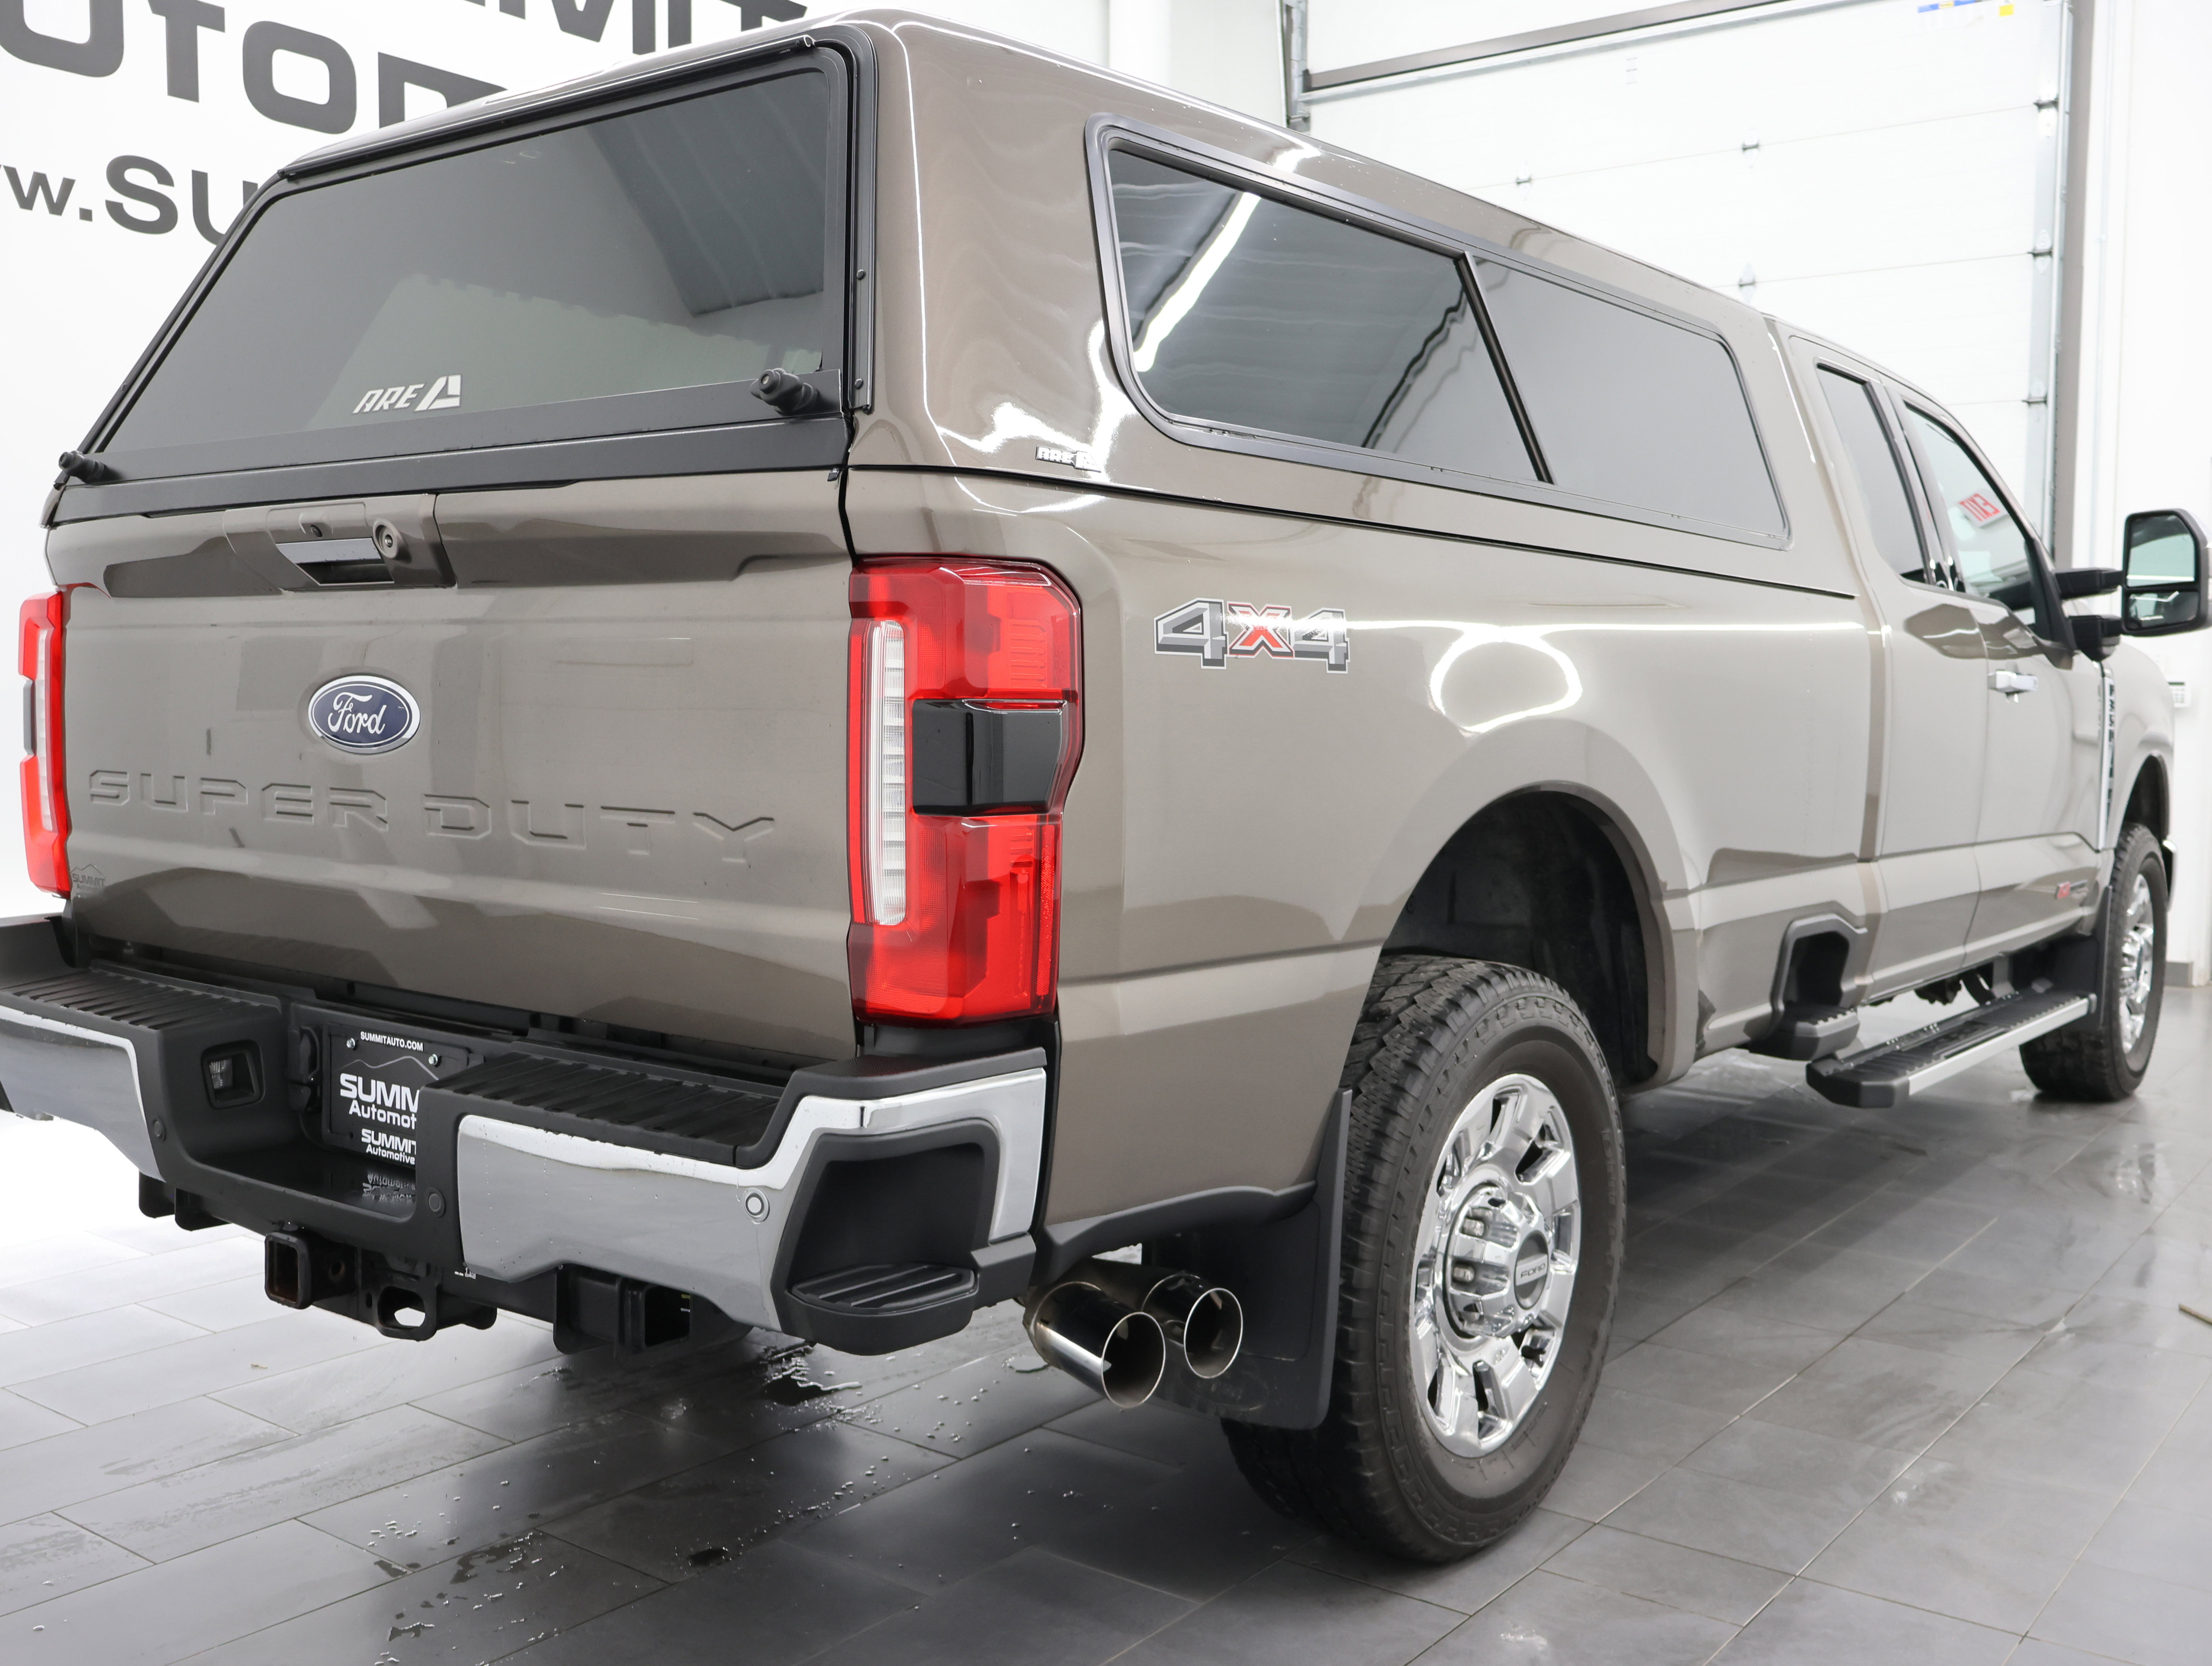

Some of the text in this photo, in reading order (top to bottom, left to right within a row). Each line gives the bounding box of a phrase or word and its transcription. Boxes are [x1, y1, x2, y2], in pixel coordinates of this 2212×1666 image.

[351, 383, 425, 414] ARE
[327, 692, 387, 734] Ford
[89, 770, 774, 863] SUPER DUTY
[361, 1031, 424, 1052] SUMMITAUTO.COM
[366, 1143, 415, 1165] Automotive
[1520, 1263, 1546, 1278] FORD
